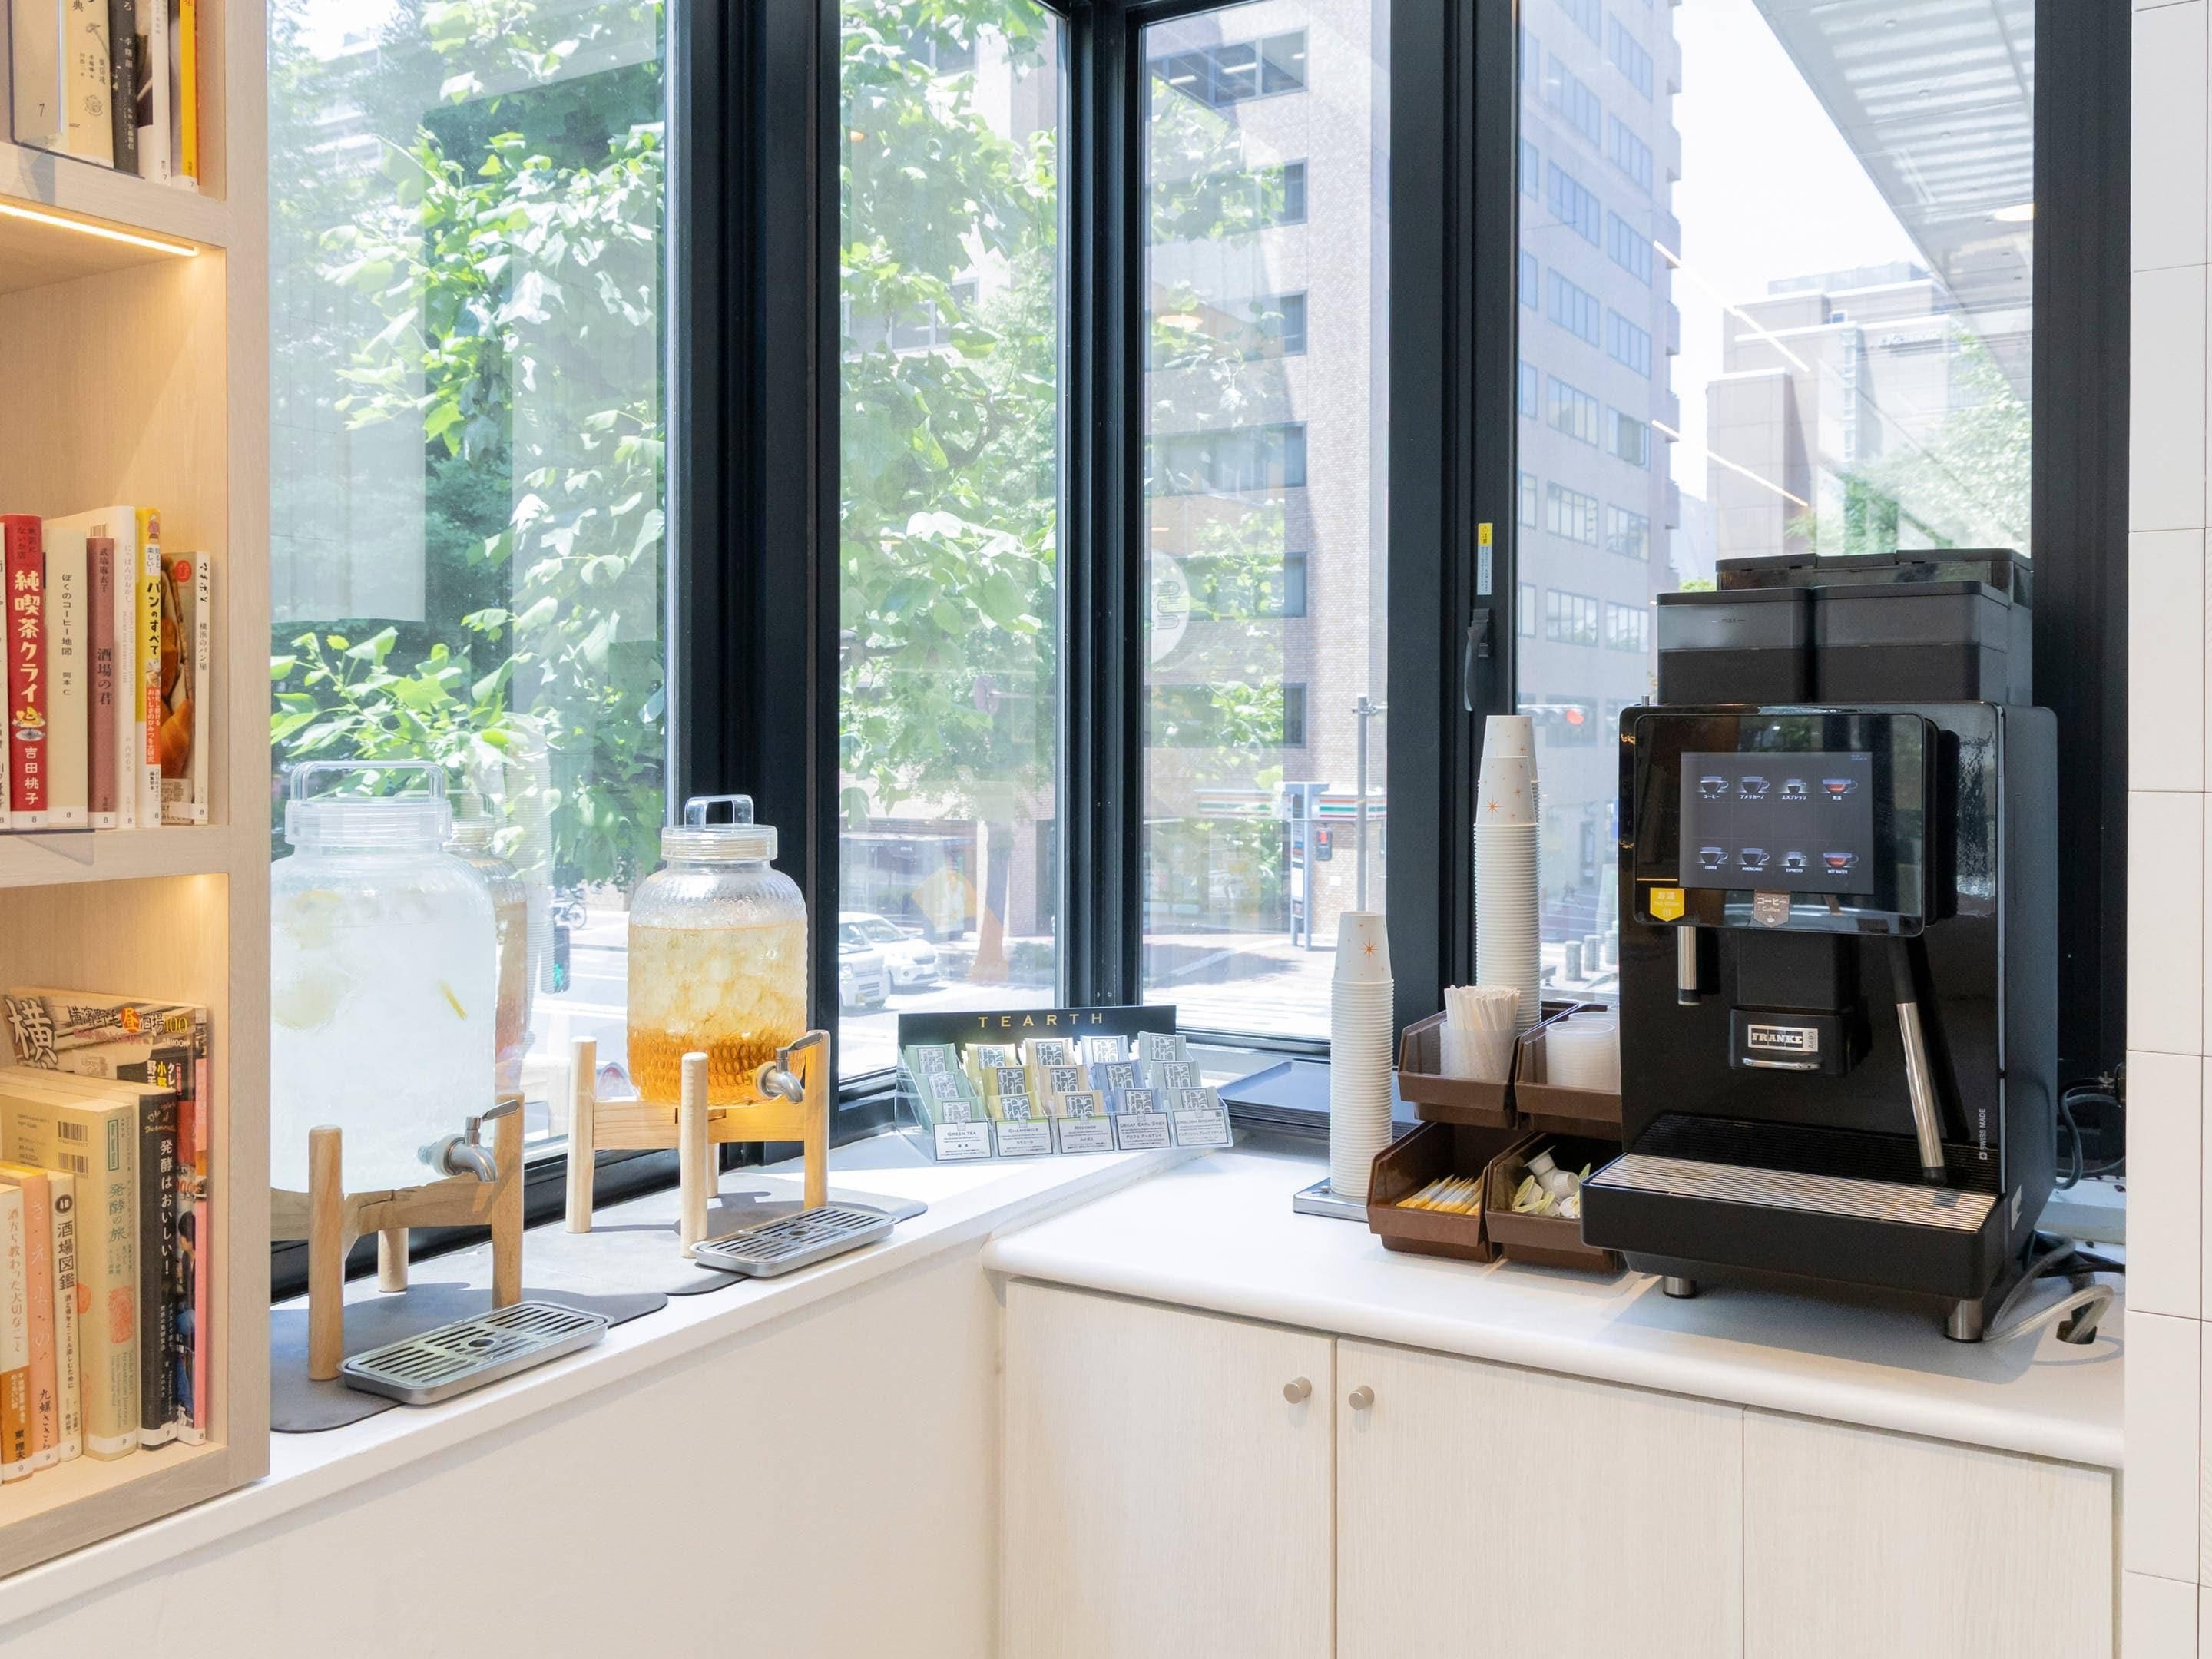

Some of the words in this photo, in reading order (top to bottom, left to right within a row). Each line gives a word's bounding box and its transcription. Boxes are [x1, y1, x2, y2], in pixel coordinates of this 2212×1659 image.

[14, 570, 40, 702] 純喫茶クライ
[61, 574, 73, 656] ぼくのコーヒー地図
[147, 582, 161, 654] パンのすべて
[98, 648, 111, 706] 酒場の君
[25, 746, 39, 805] 吉田桃子
[1757, 897, 1788, 906] コーヒー
[978, 1013, 1104, 1028] TEARTH
[1751, 1032, 1803, 1045] FRANKE
[107, 1183, 127, 1243] 発酵の旅
[160, 1139, 174, 1275] 発酵はおいしい！
[57, 1220, 75, 1291] 酒場図鑑
